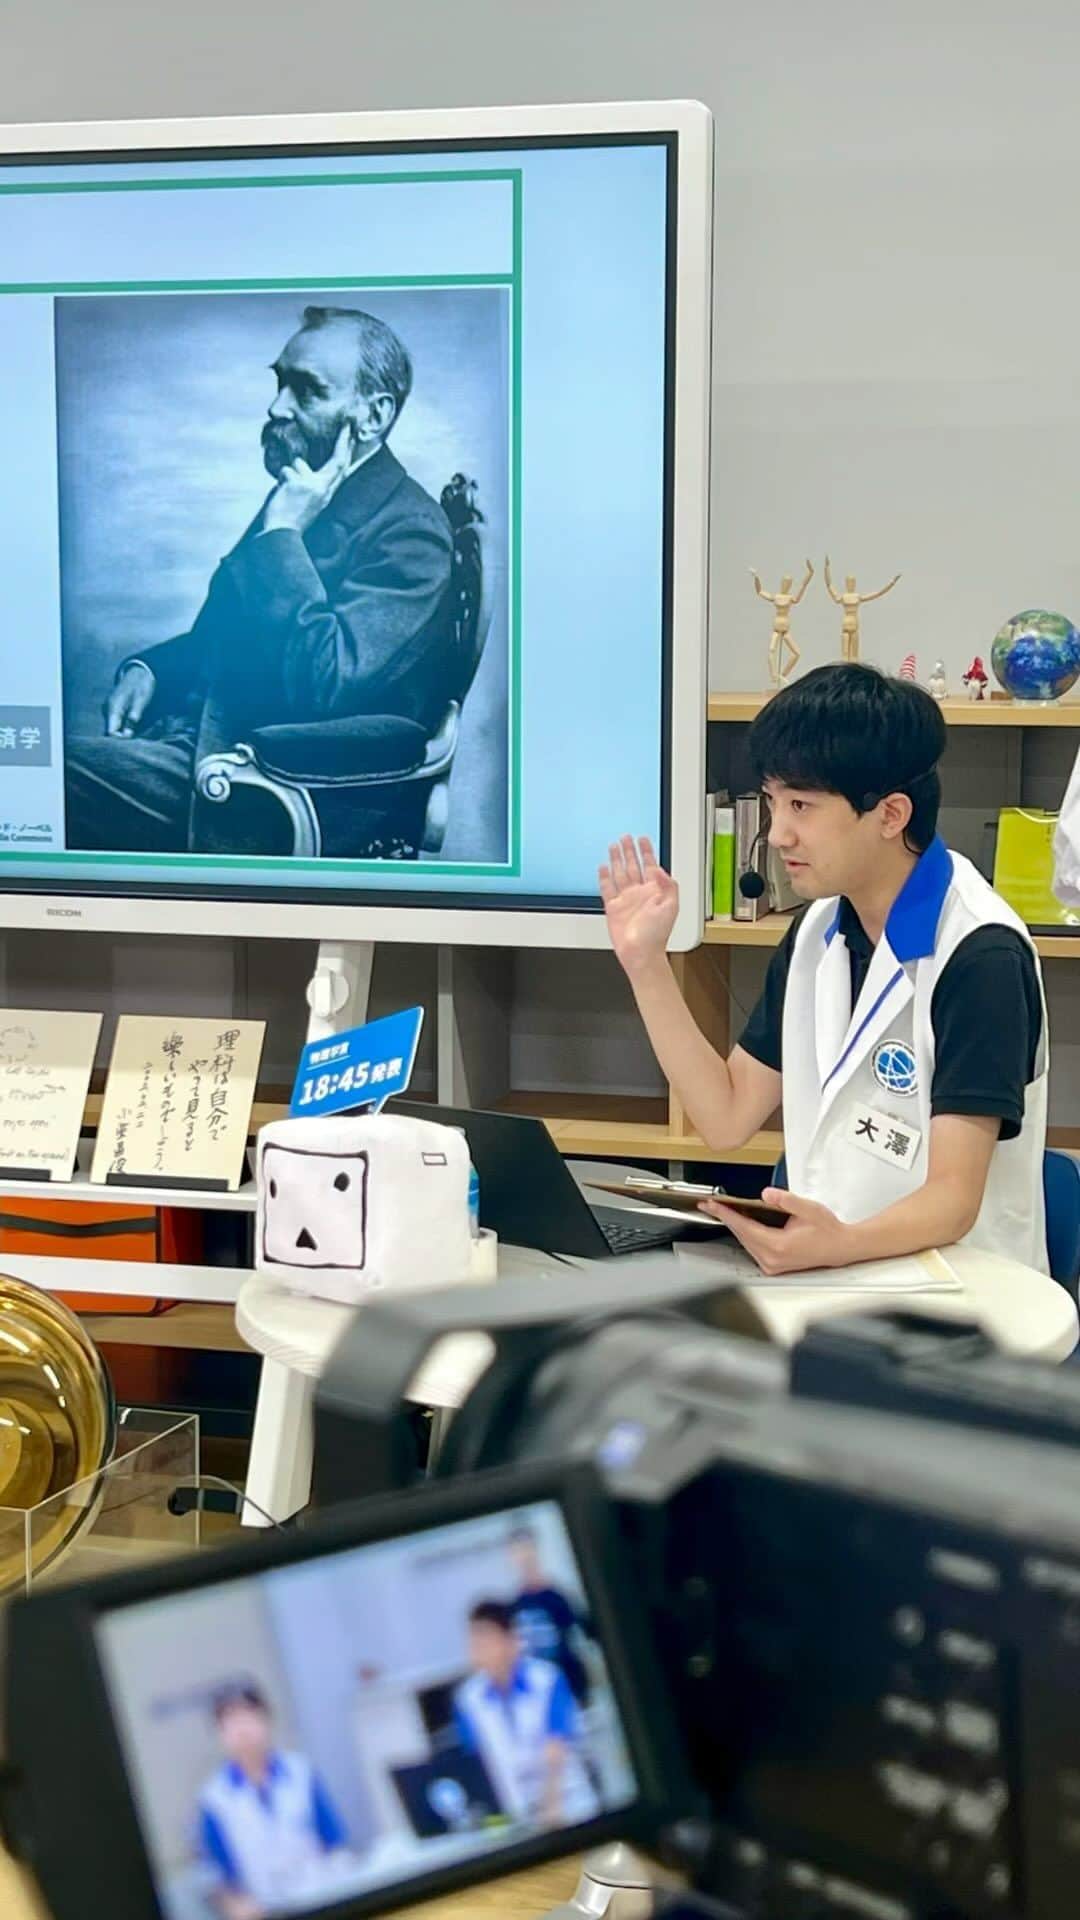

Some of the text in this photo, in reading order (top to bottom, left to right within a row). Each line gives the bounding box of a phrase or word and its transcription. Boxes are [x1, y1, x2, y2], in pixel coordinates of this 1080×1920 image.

[206, 1028, 241, 1141] 理科は自分で
[299, 1057, 403, 1105] 18:45発表
[855, 1117, 911, 1157] 大澤
